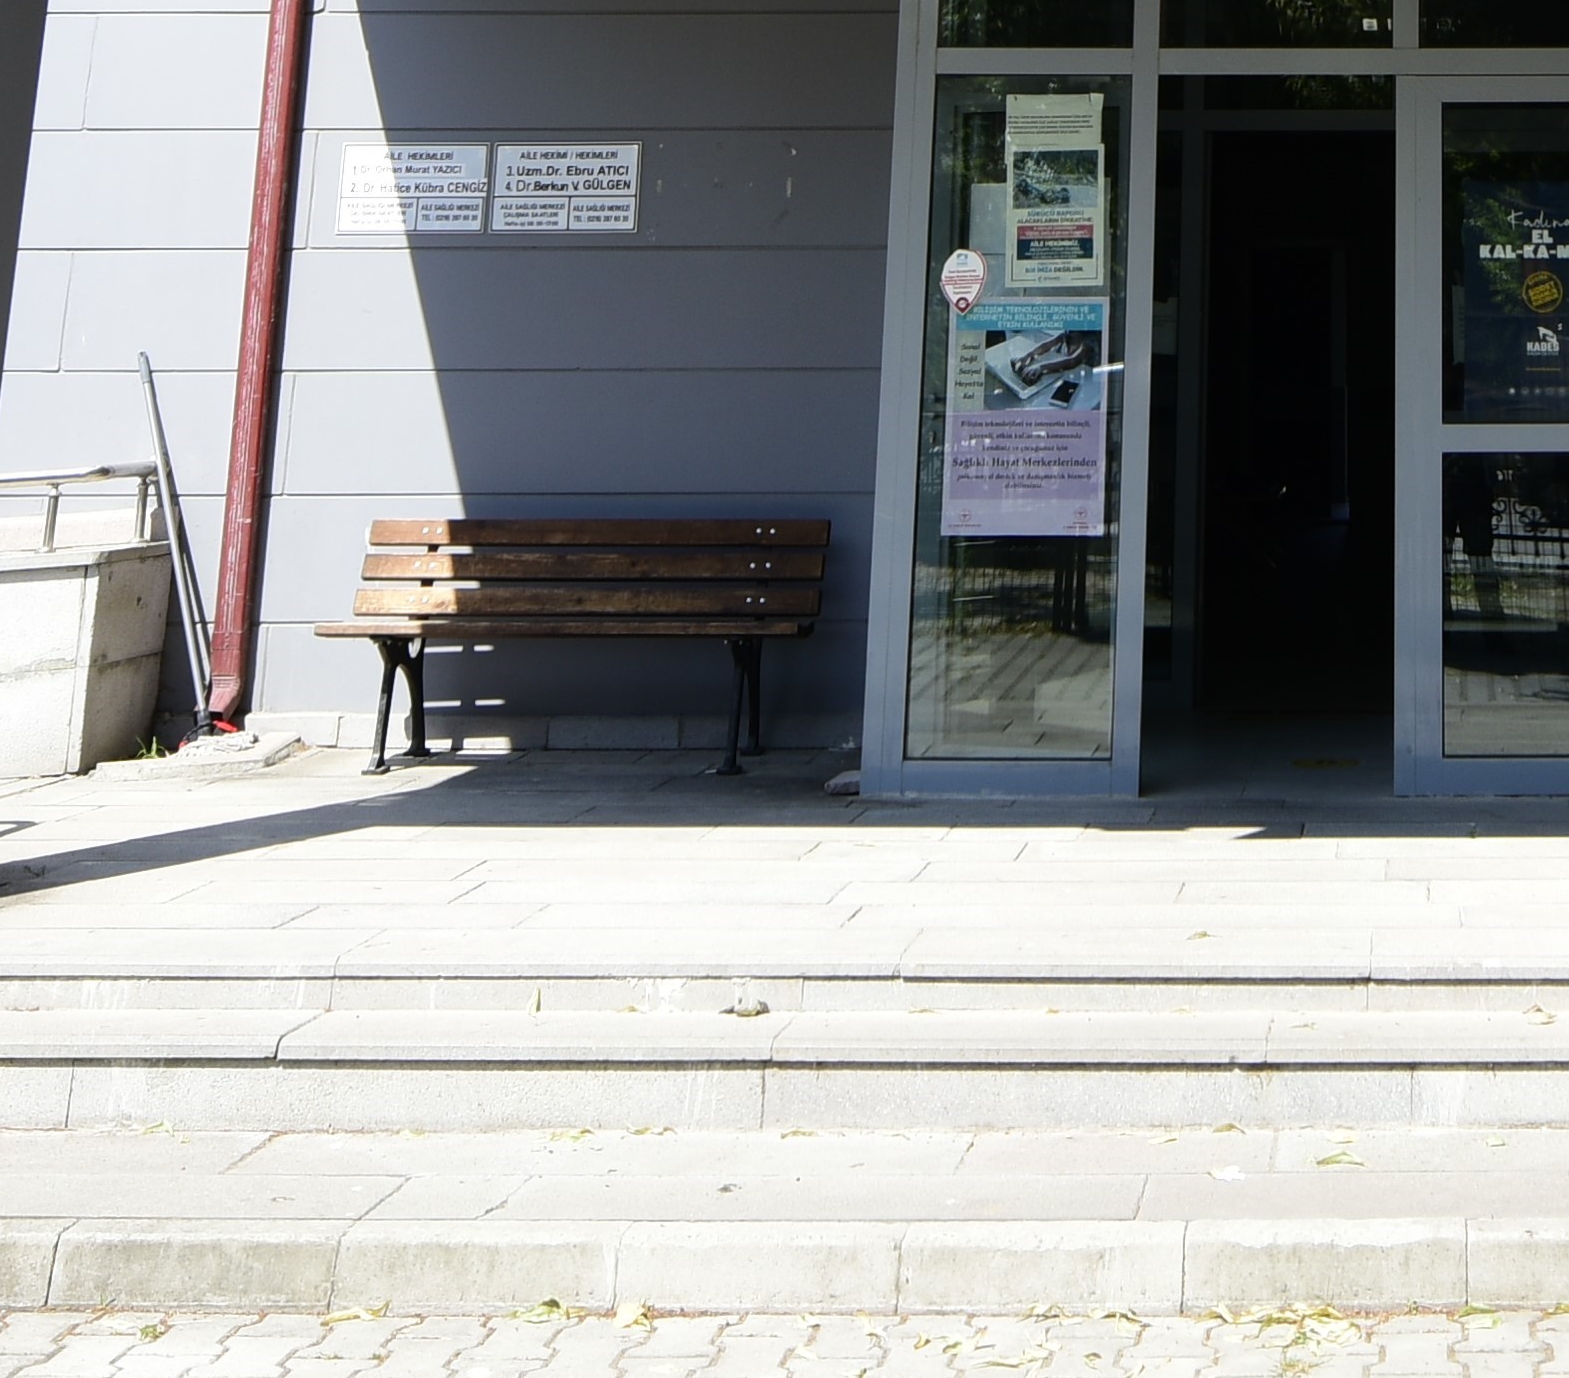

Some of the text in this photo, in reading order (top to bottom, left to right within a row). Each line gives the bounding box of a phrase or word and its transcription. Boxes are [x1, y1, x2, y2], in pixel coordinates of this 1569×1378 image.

[407, 150, 454, 160] HEKİMLERİ
[519, 151, 537, 160] AİLE
[540, 151, 568, 160] HEKİMİ
[575, 151, 619, 160] HEKİMLERİ
[405, 165, 430, 174] Murat
[433, 165, 462, 174] YAZICI
[567, 165, 594, 176] Ebru
[597, 165, 629, 176] ATICI
[381, 182, 411, 193] Hatice
[414, 182, 444, 193] Kübra
[447, 179, 487, 193] CENGİZ
[583, 178, 631, 190] GÜLGEN
[515, 202, 537, 210] SAĞLIĞI
[1531, 230, 1553, 244] EL
[1527, 342, 1559, 352] KADES
[992, 458, 1019, 469] Hayat
[1022, 457, 1097, 467] Merkezlerinden
